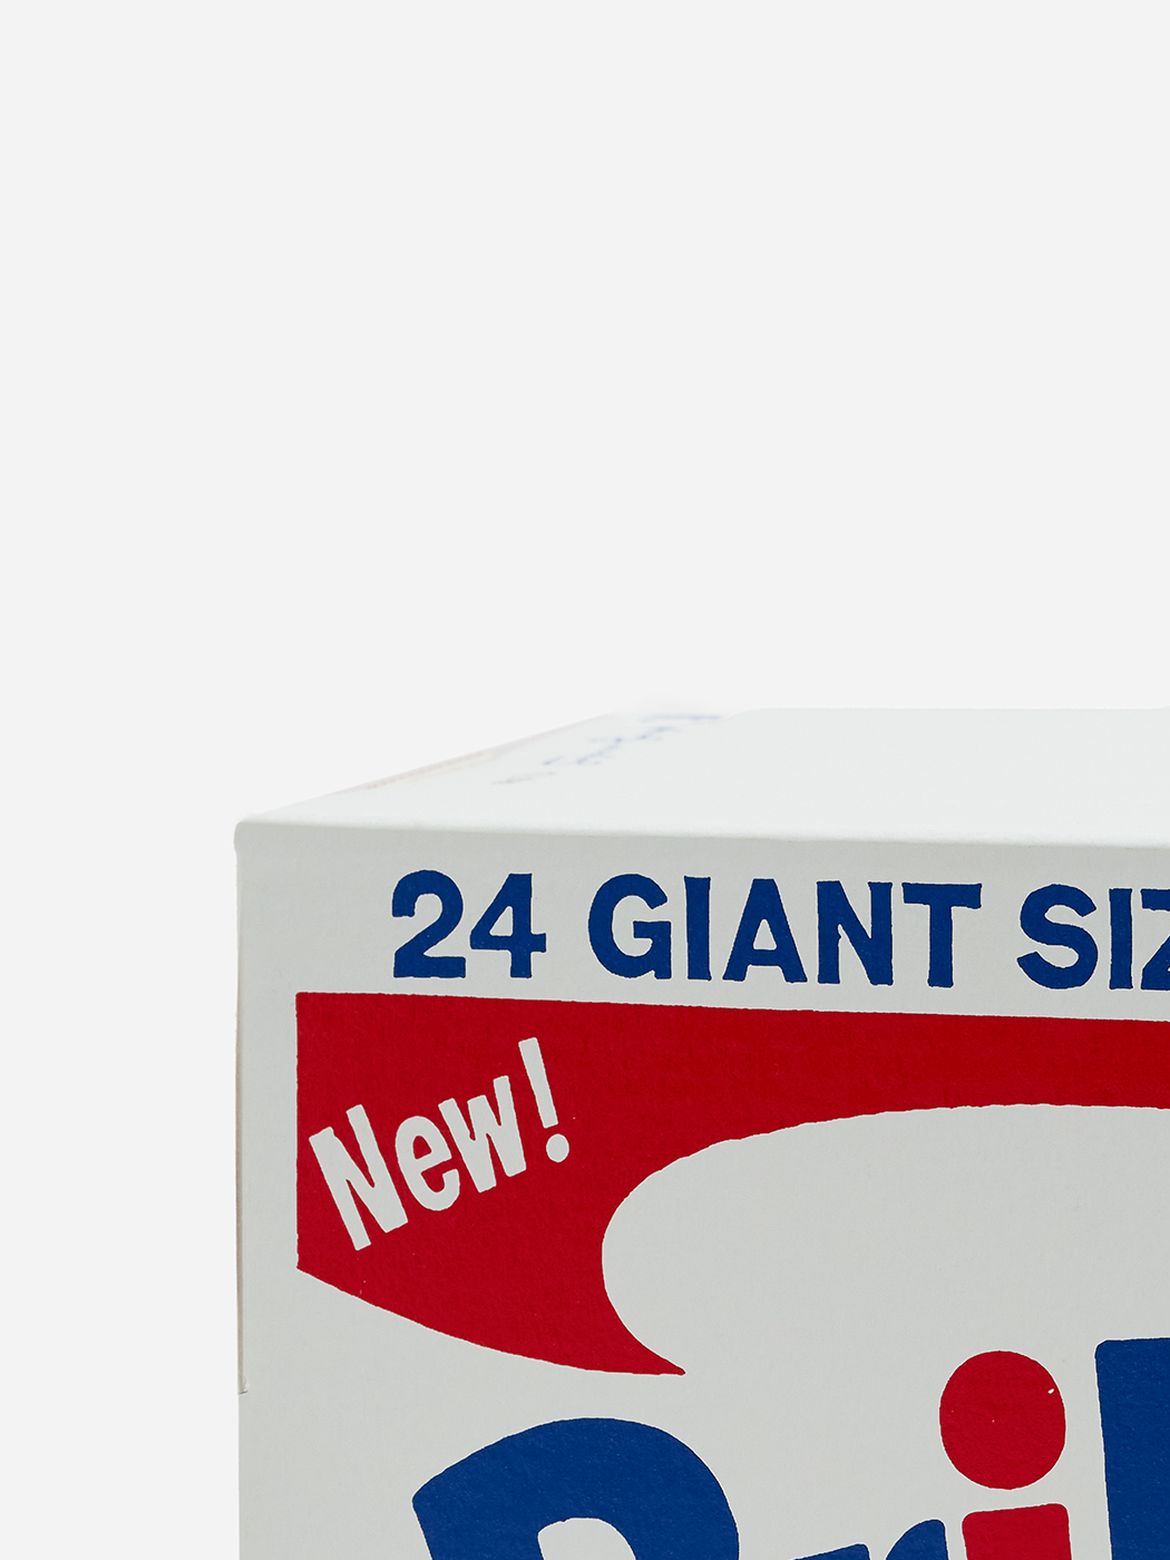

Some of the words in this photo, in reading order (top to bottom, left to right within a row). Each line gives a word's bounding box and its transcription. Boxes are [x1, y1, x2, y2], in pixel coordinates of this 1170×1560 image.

[390, 868, 548, 980] 24
[587, 873, 983, 989] GIANT
[308, 1036, 570, 1251] New!
